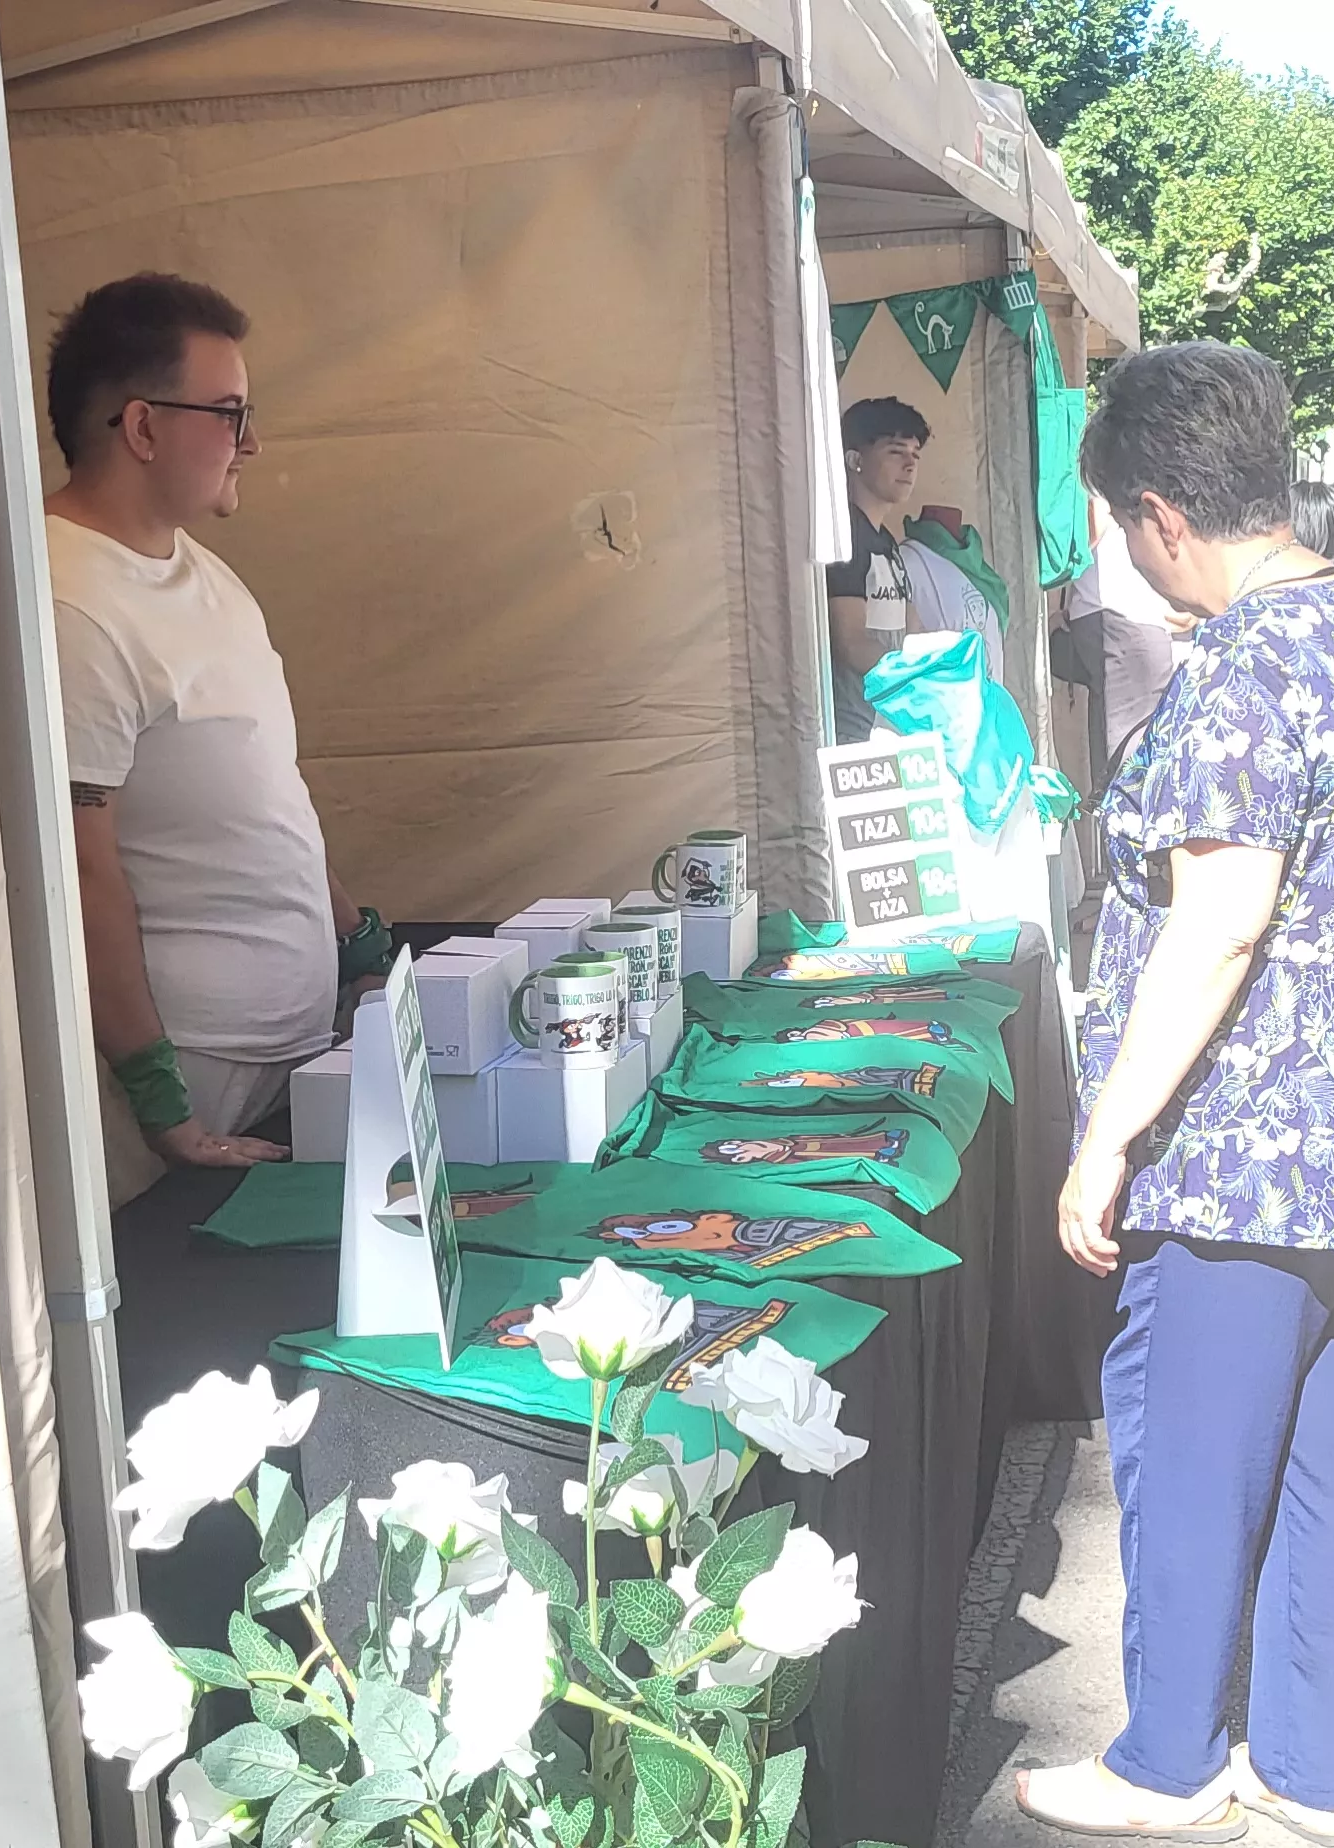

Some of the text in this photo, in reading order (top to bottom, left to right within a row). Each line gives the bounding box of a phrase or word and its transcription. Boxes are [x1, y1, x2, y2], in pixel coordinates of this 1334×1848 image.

[836, 761, 897, 792] BOLSA
[850, 814, 900, 844] TAZA
[860, 866, 909, 893] BOLSA
[869, 896, 909, 920] TAZA
